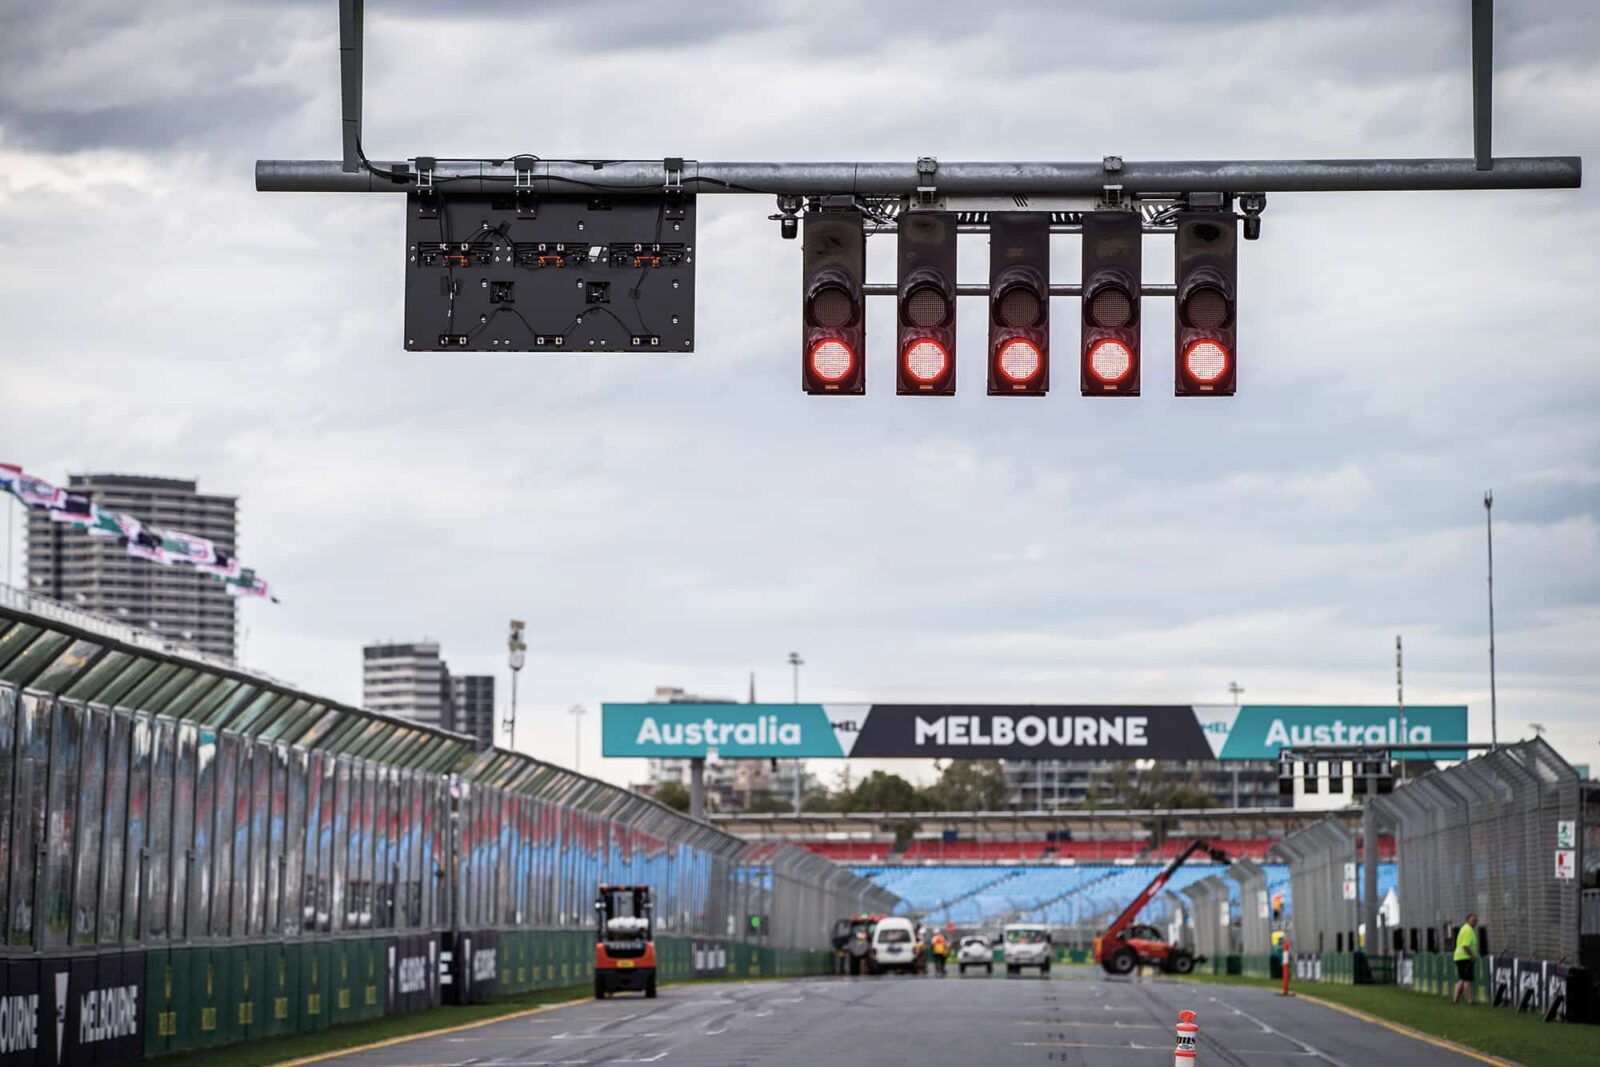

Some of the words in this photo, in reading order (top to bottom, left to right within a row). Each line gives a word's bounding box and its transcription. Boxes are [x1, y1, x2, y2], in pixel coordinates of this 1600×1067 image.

[637, 716, 800, 745] Australia
[915, 716, 1148, 746] MELBOURNE
[1265, 718, 1431, 746] Australia
